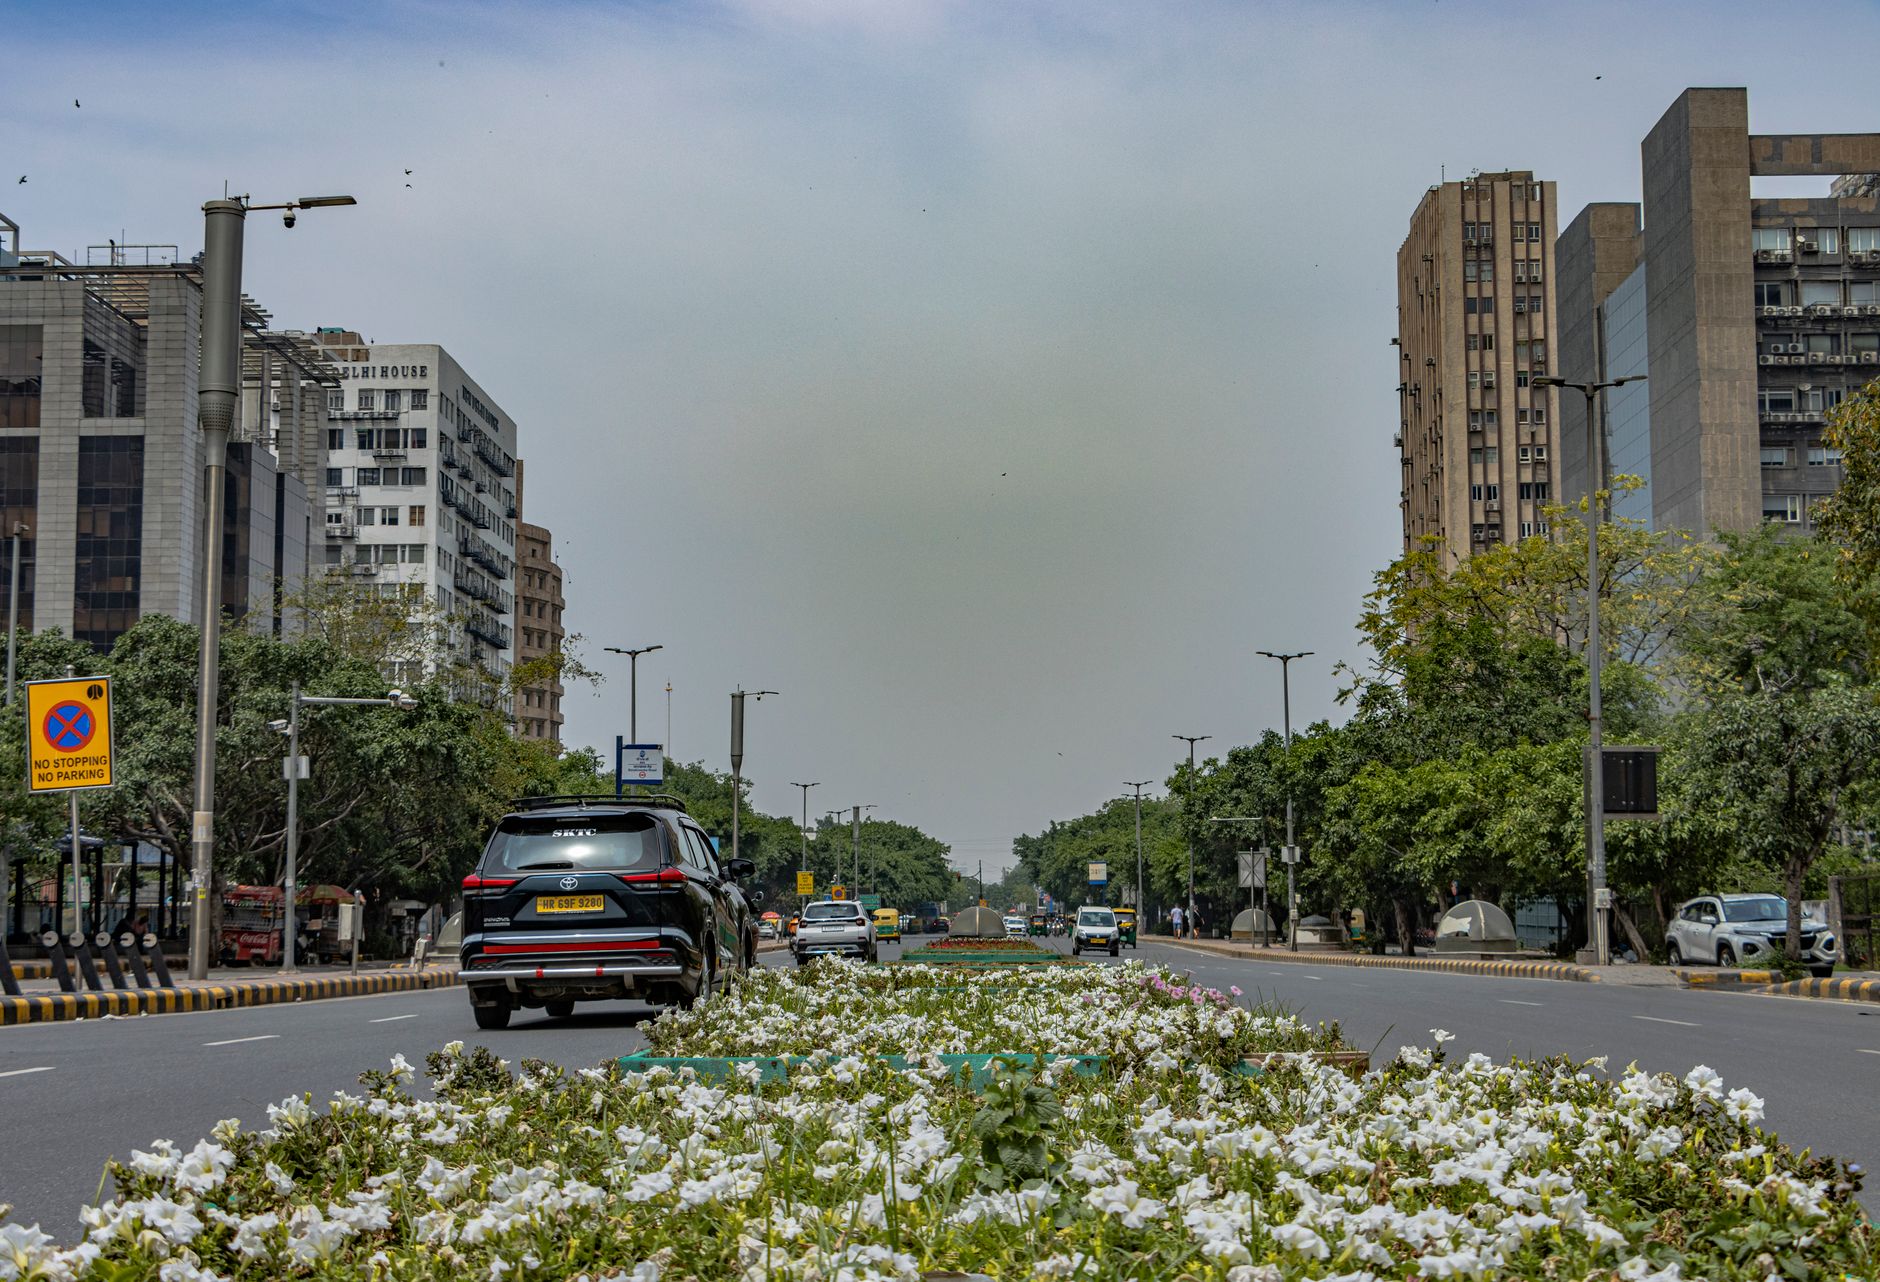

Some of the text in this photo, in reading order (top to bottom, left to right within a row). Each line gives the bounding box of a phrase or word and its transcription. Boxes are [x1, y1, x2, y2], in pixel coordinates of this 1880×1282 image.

[380, 366, 428, 378] HOUSE
[34, 755, 108, 770] NO STOPPING
[38, 768, 105, 782] NO PARKING
[552, 829, 597, 837] SKTC
[543, 899, 555, 909] HR
